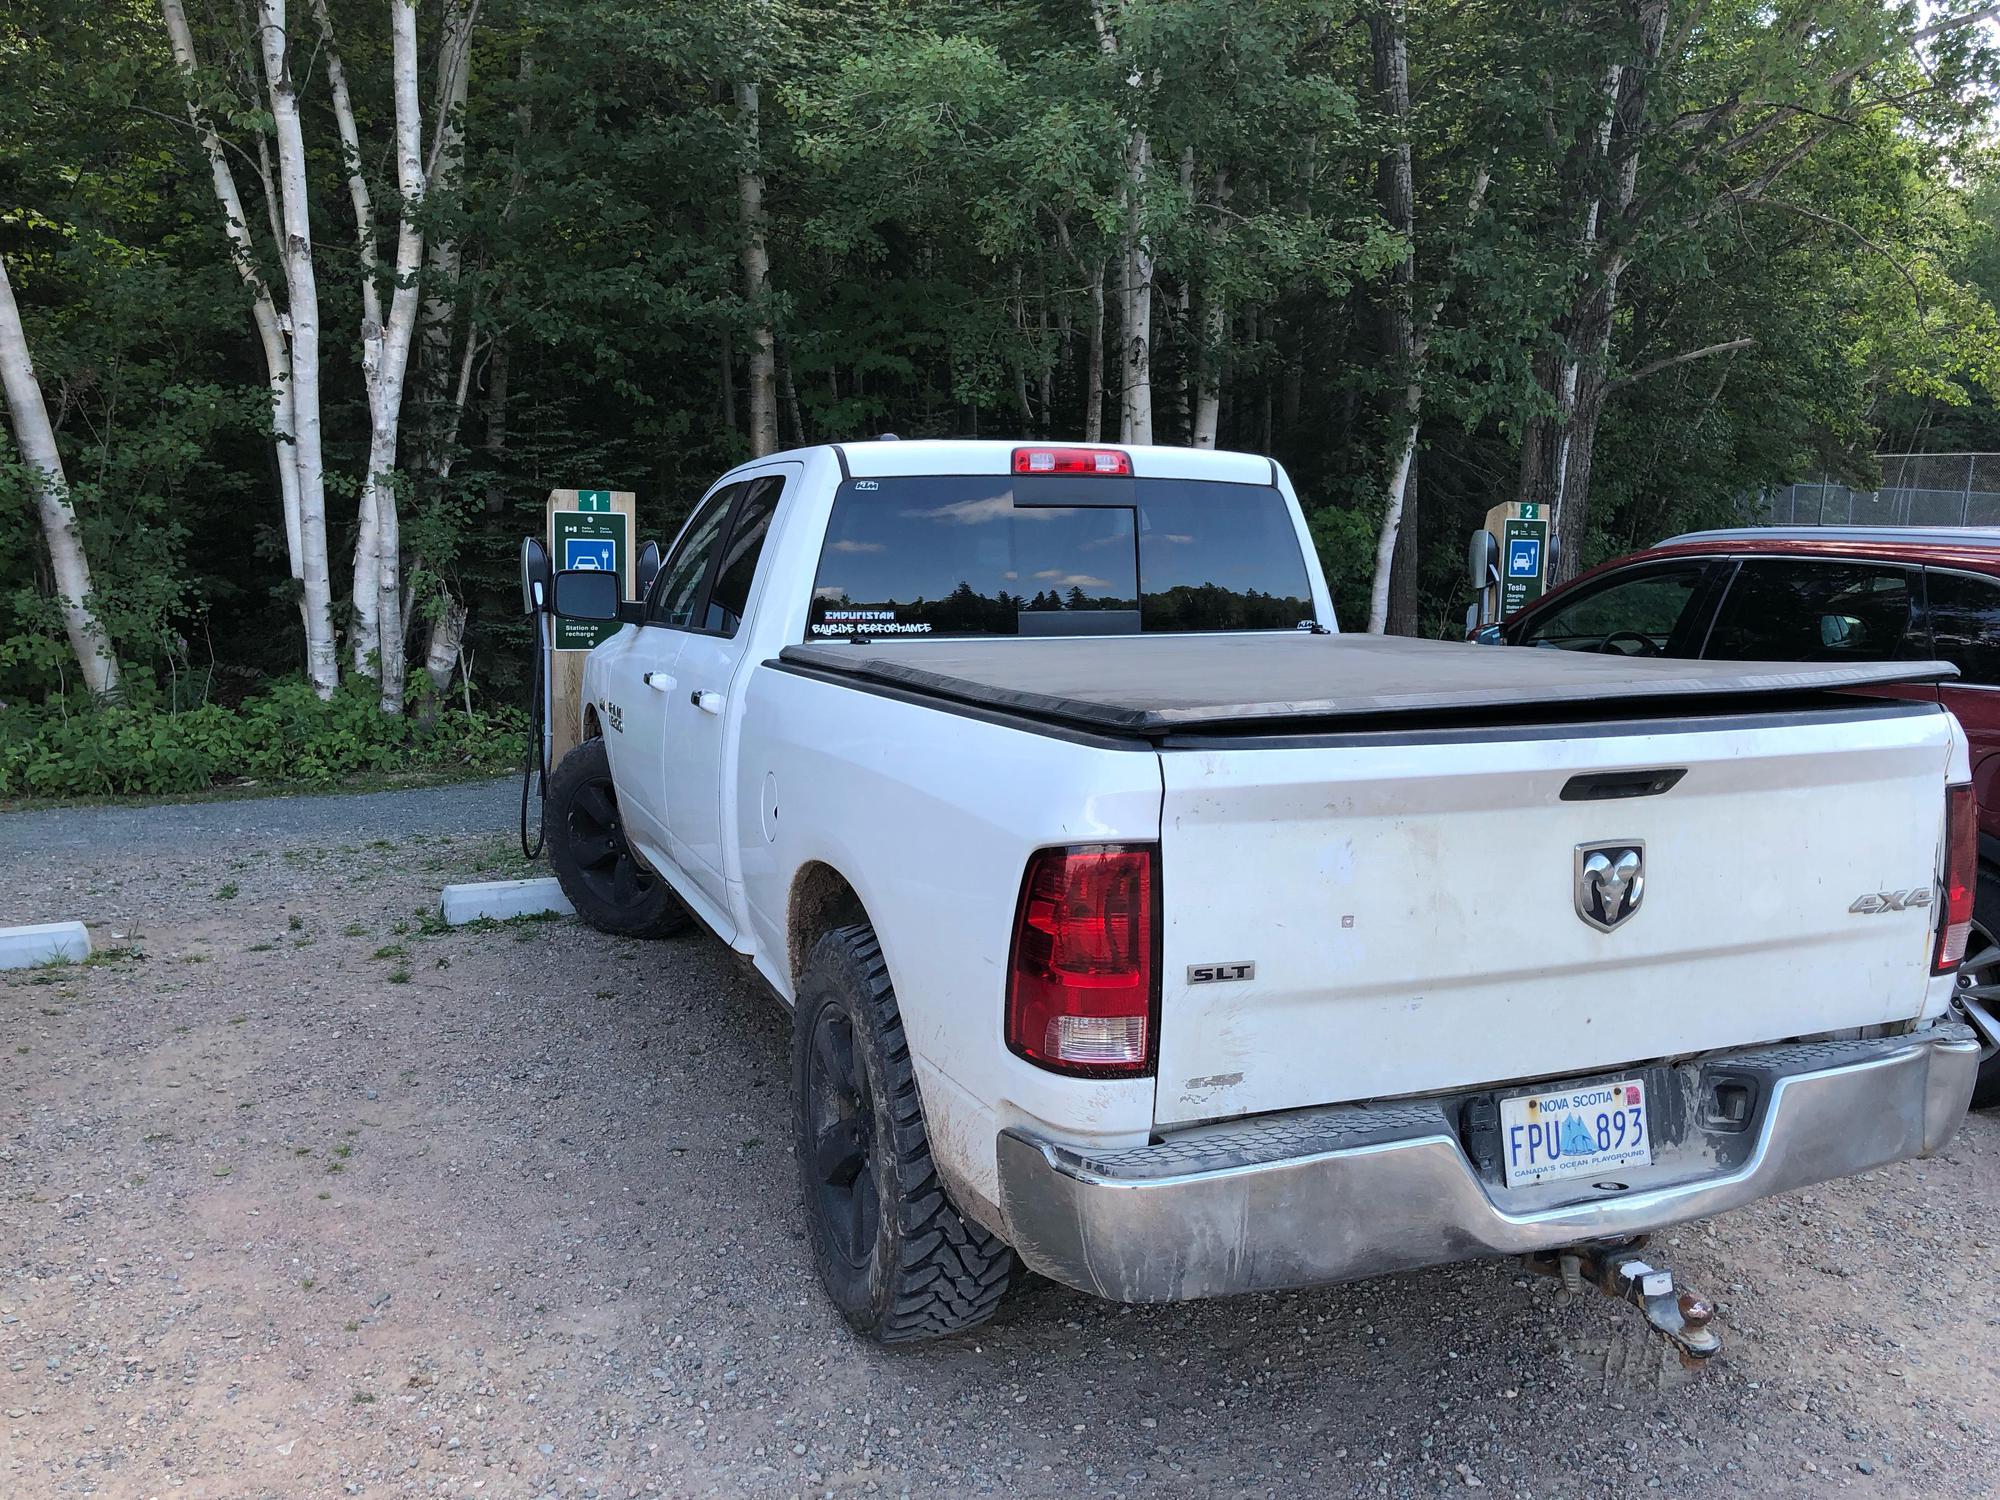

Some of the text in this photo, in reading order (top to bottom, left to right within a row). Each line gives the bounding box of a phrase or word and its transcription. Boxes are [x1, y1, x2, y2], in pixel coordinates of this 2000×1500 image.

[856, 482, 878, 490] KTM
[589, 493, 598, 511] 1
[1872, 491, 1879, 503] 2
[1525, 505, 1533, 518] 2
[1507, 583, 1526, 592] Tesla
[1193, 965, 1251, 982] SLT
[1539, 1091, 1613, 1113] NOVA SCOTIA
[1510, 1107, 1643, 1167] FPU 893
[1514, 1150, 1645, 1178] CANADA'S OCEAN PLAYGROUND
